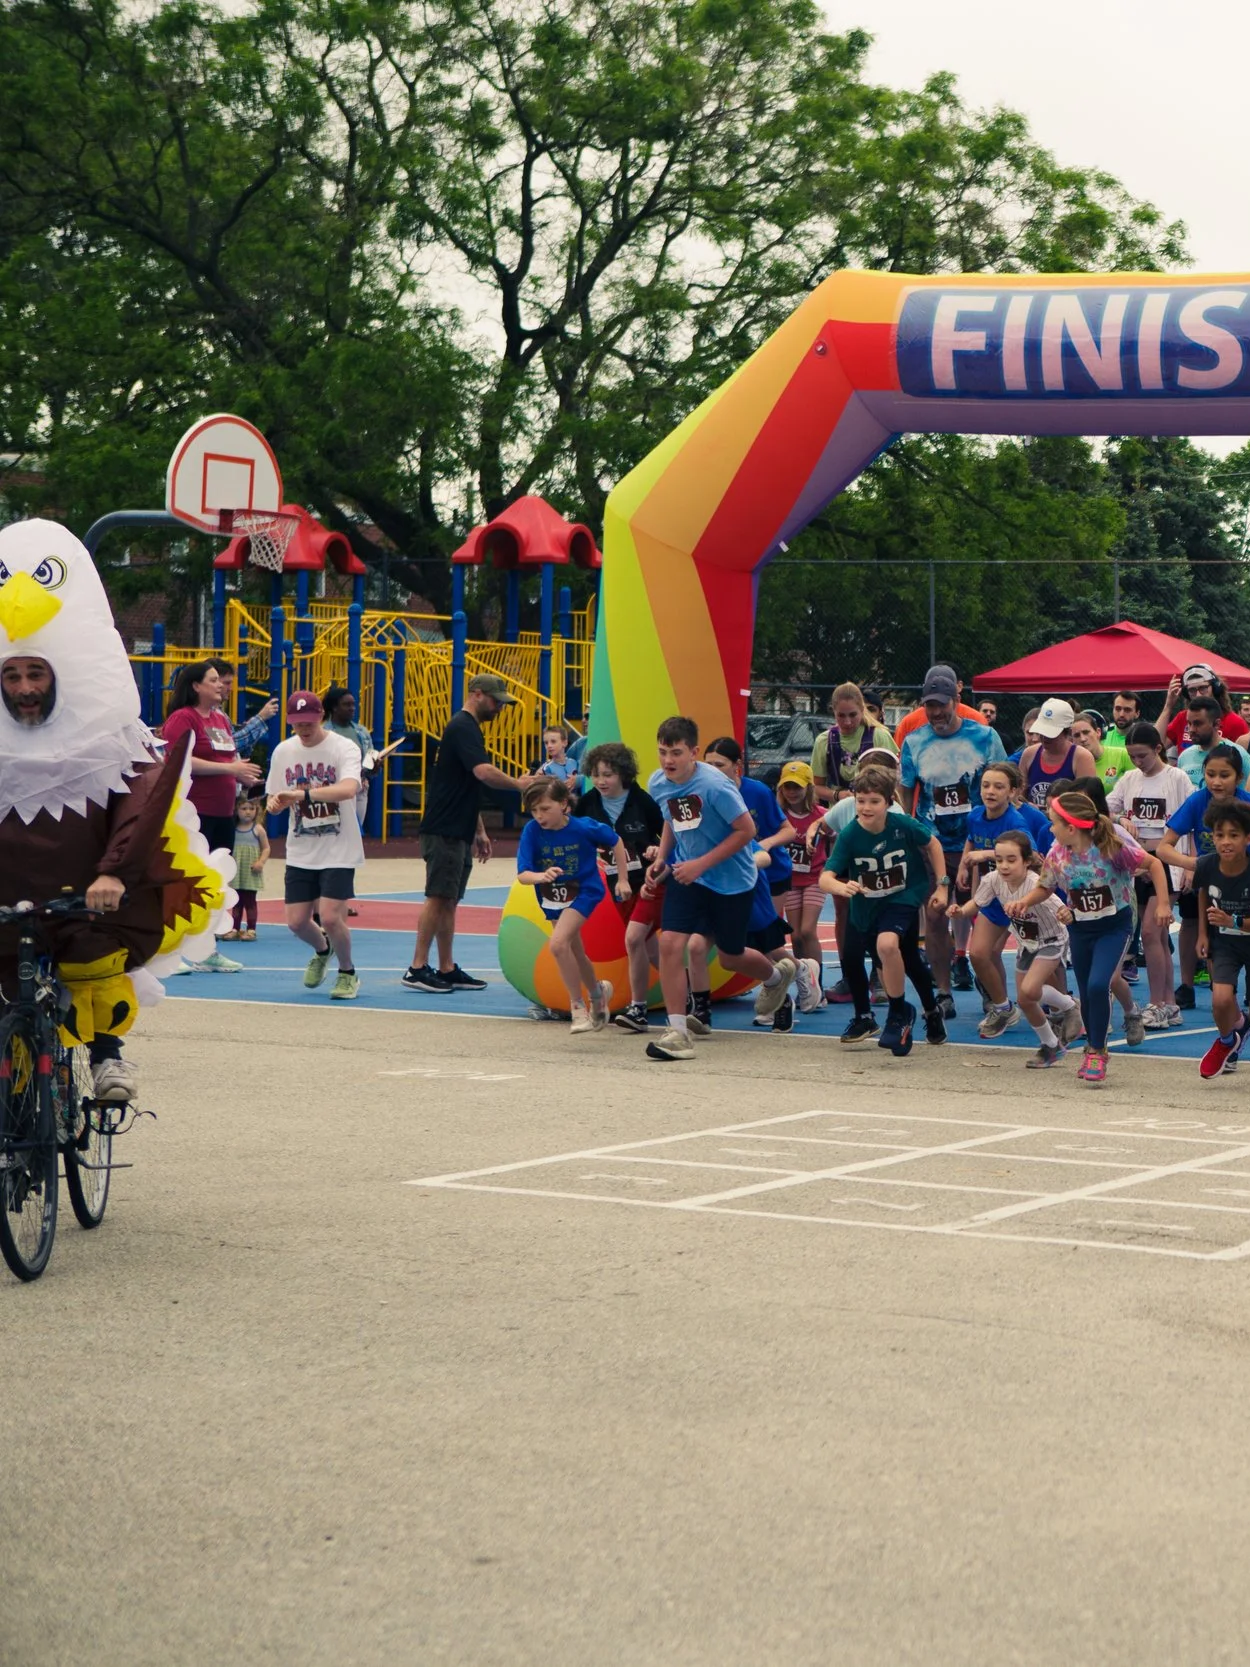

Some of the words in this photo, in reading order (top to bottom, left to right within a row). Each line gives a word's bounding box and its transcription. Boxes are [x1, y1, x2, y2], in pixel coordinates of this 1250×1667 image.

[945, 791, 959, 806] 63
[308, 802, 329, 818] 171
[678, 803, 693, 820] 35
[1139, 804, 1159, 819] 207
[608, 847, 631, 864] 21
[876, 874, 891, 889] 61
[551, 887, 568, 902] 39
[1080, 894, 1103, 911] 157
